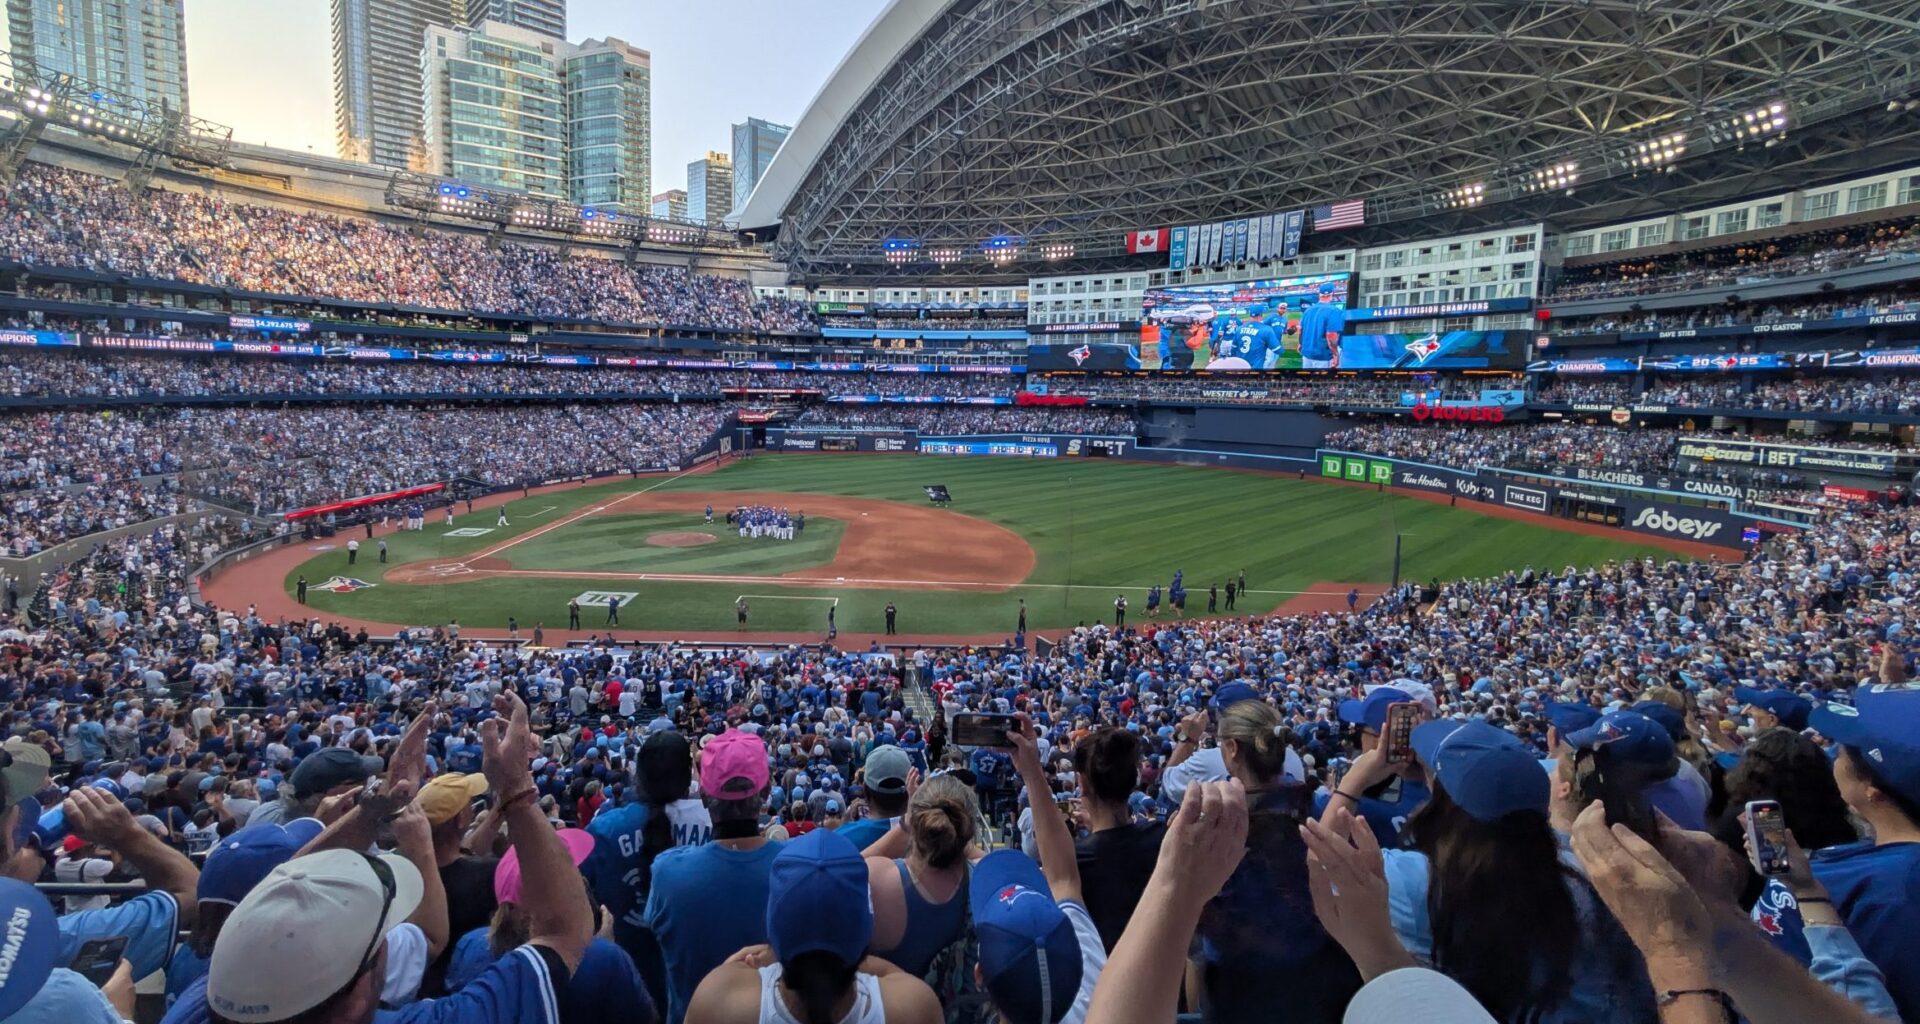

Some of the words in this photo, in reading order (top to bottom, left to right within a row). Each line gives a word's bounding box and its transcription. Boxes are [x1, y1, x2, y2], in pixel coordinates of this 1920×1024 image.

[1285, 231, 1301, 244] 32
[1373, 309, 1382, 317] AL
[1384, 307, 1402, 316] EAST
[1404, 305, 1438, 315] DIVISION
[1441, 302, 1489, 313] CHAMPIONS
[1090, 322, 1120, 330] CHAMPIONS
[1869, 315, 1885, 325] PAT
[1885, 313, 1917, 323] GILLICK
[1240, 327, 1259, 336] STRAW
[1753, 325, 1770, 333] CITO
[1772, 323, 1803, 331] GASTON
[92, 336, 103, 345] AL
[106, 338, 126, 346] EAST
[129, 338, 167, 347] DIVISION
[170, 340, 214, 350] CHAMPIONS
[232, 343, 271, 352] TORONTO
[1240, 335, 1251, 354] 3
[351, 350, 391, 359] CHAMPIONS
[1739, 357, 1758, 366] 25
[1556, 363, 1606, 371] CHAMPIONS
[1692, 358, 1709, 367] 20
[1432, 406, 1505, 423] ROGERS
[1634, 405, 1667, 413] BLEACHERS
[1679, 444, 1755, 462] theScore
[1768, 450, 1798, 466] BET
[1800, 457, 1847, 468] SPORTSBOOK
[1855, 462, 1885, 470] CASINO
[1325, 459, 1339, 473] TD
[1348, 462, 1364, 476] TD
[1372, 465, 1390, 480] TD
[1402, 472, 1417, 485] Tim
[1417, 475, 1448, 491] Hortons
[1578, 468, 1645, 486] BLEACHERS
[1684, 481, 1743, 499] CANADA
[1510, 492, 1524, 501] THE
[1526, 495, 1542, 504] KEG
[1632, 507, 1722, 539] Sobeys
[979, 759, 997, 774] 27
